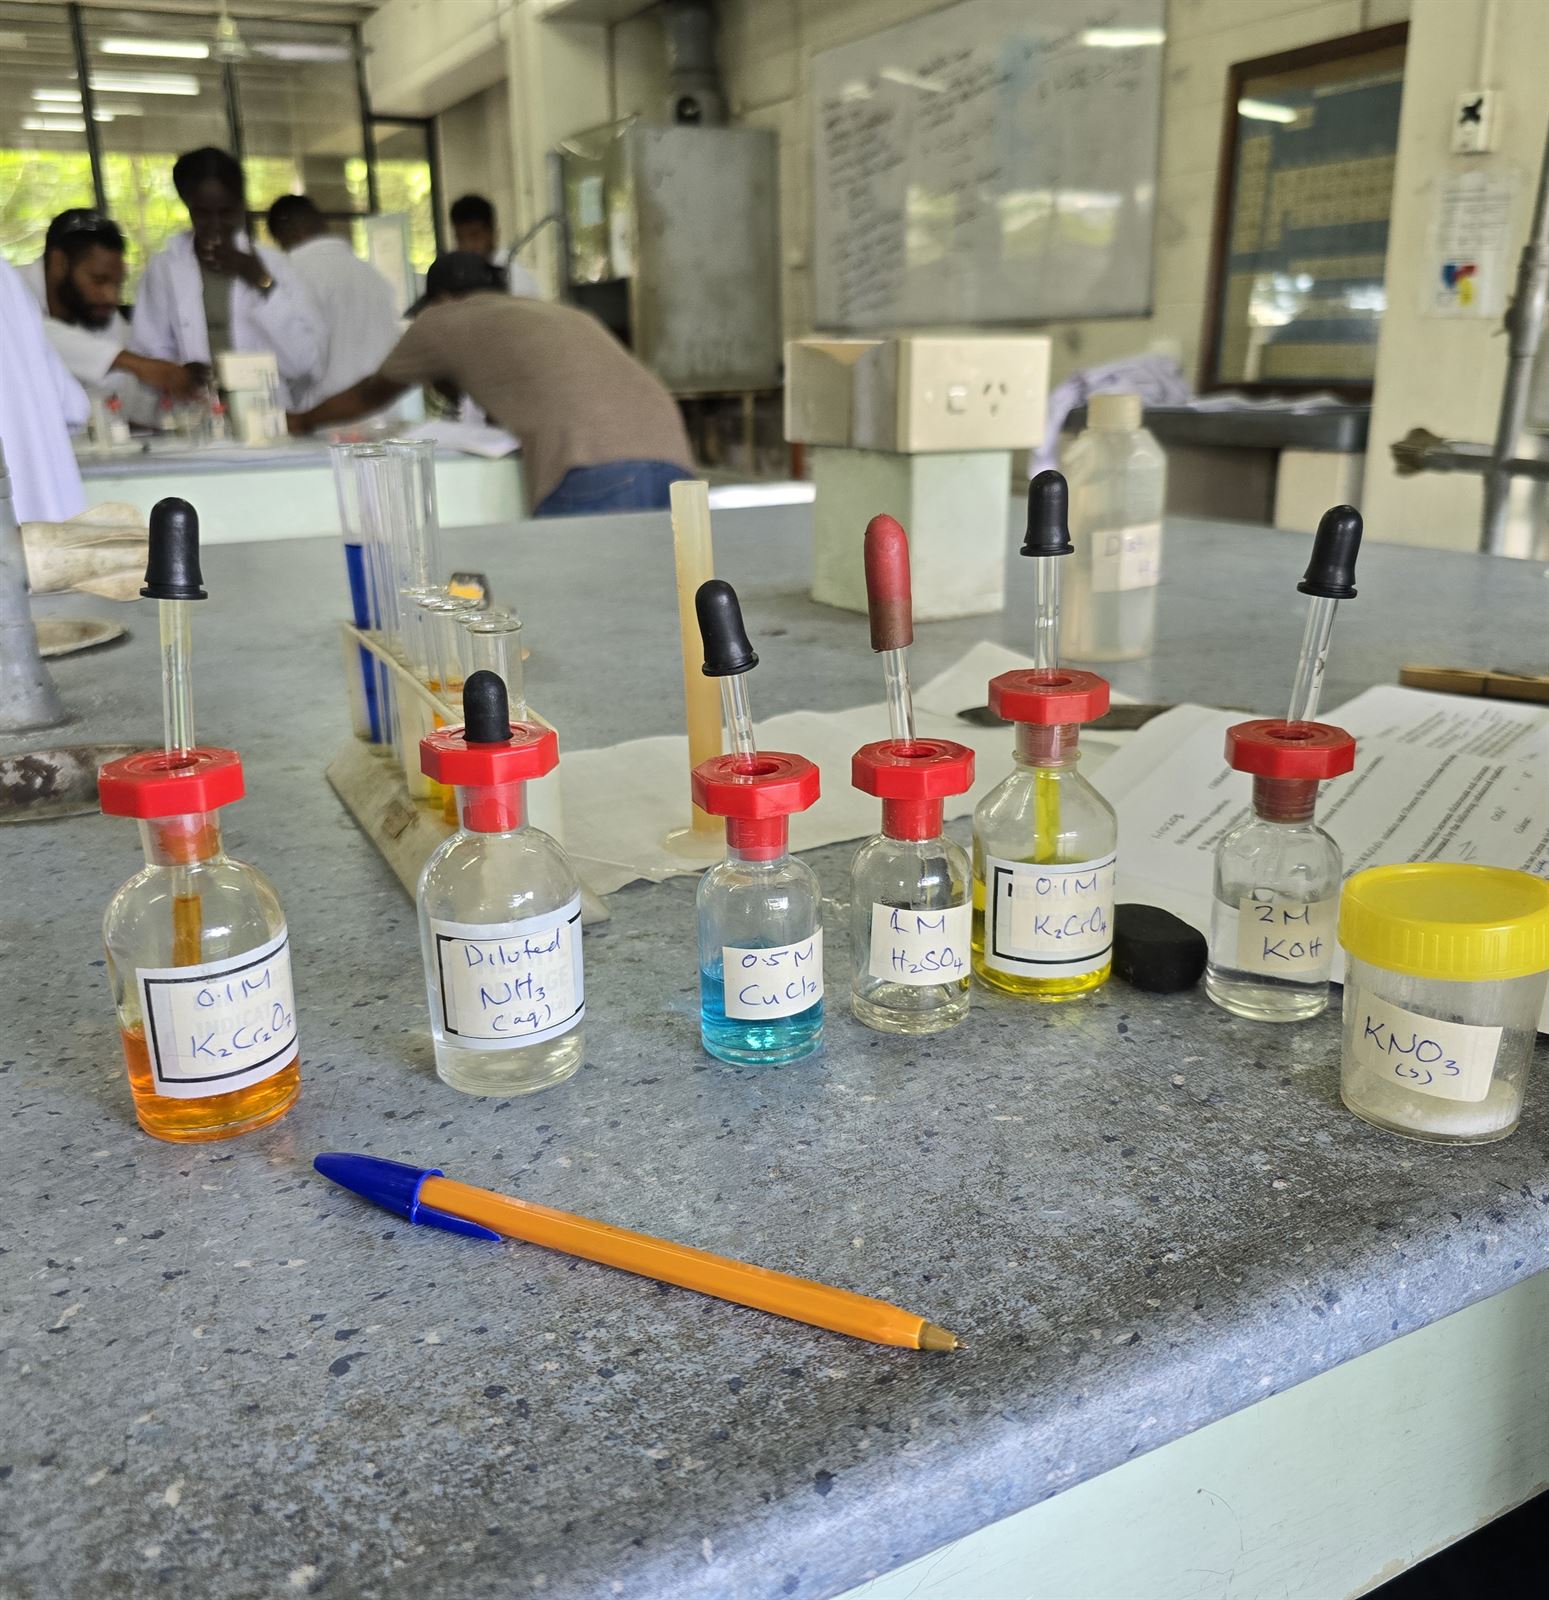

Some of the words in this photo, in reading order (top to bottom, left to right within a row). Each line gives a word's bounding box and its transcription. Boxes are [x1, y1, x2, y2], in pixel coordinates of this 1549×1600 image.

[464, 927, 561, 967] Diluted
[1262, 936, 1323, 961] KOH
[480, 972, 546, 1010] NH3
[491, 1004, 552, 1031] (aq)
[1364, 1015, 1460, 1077] KNO3
